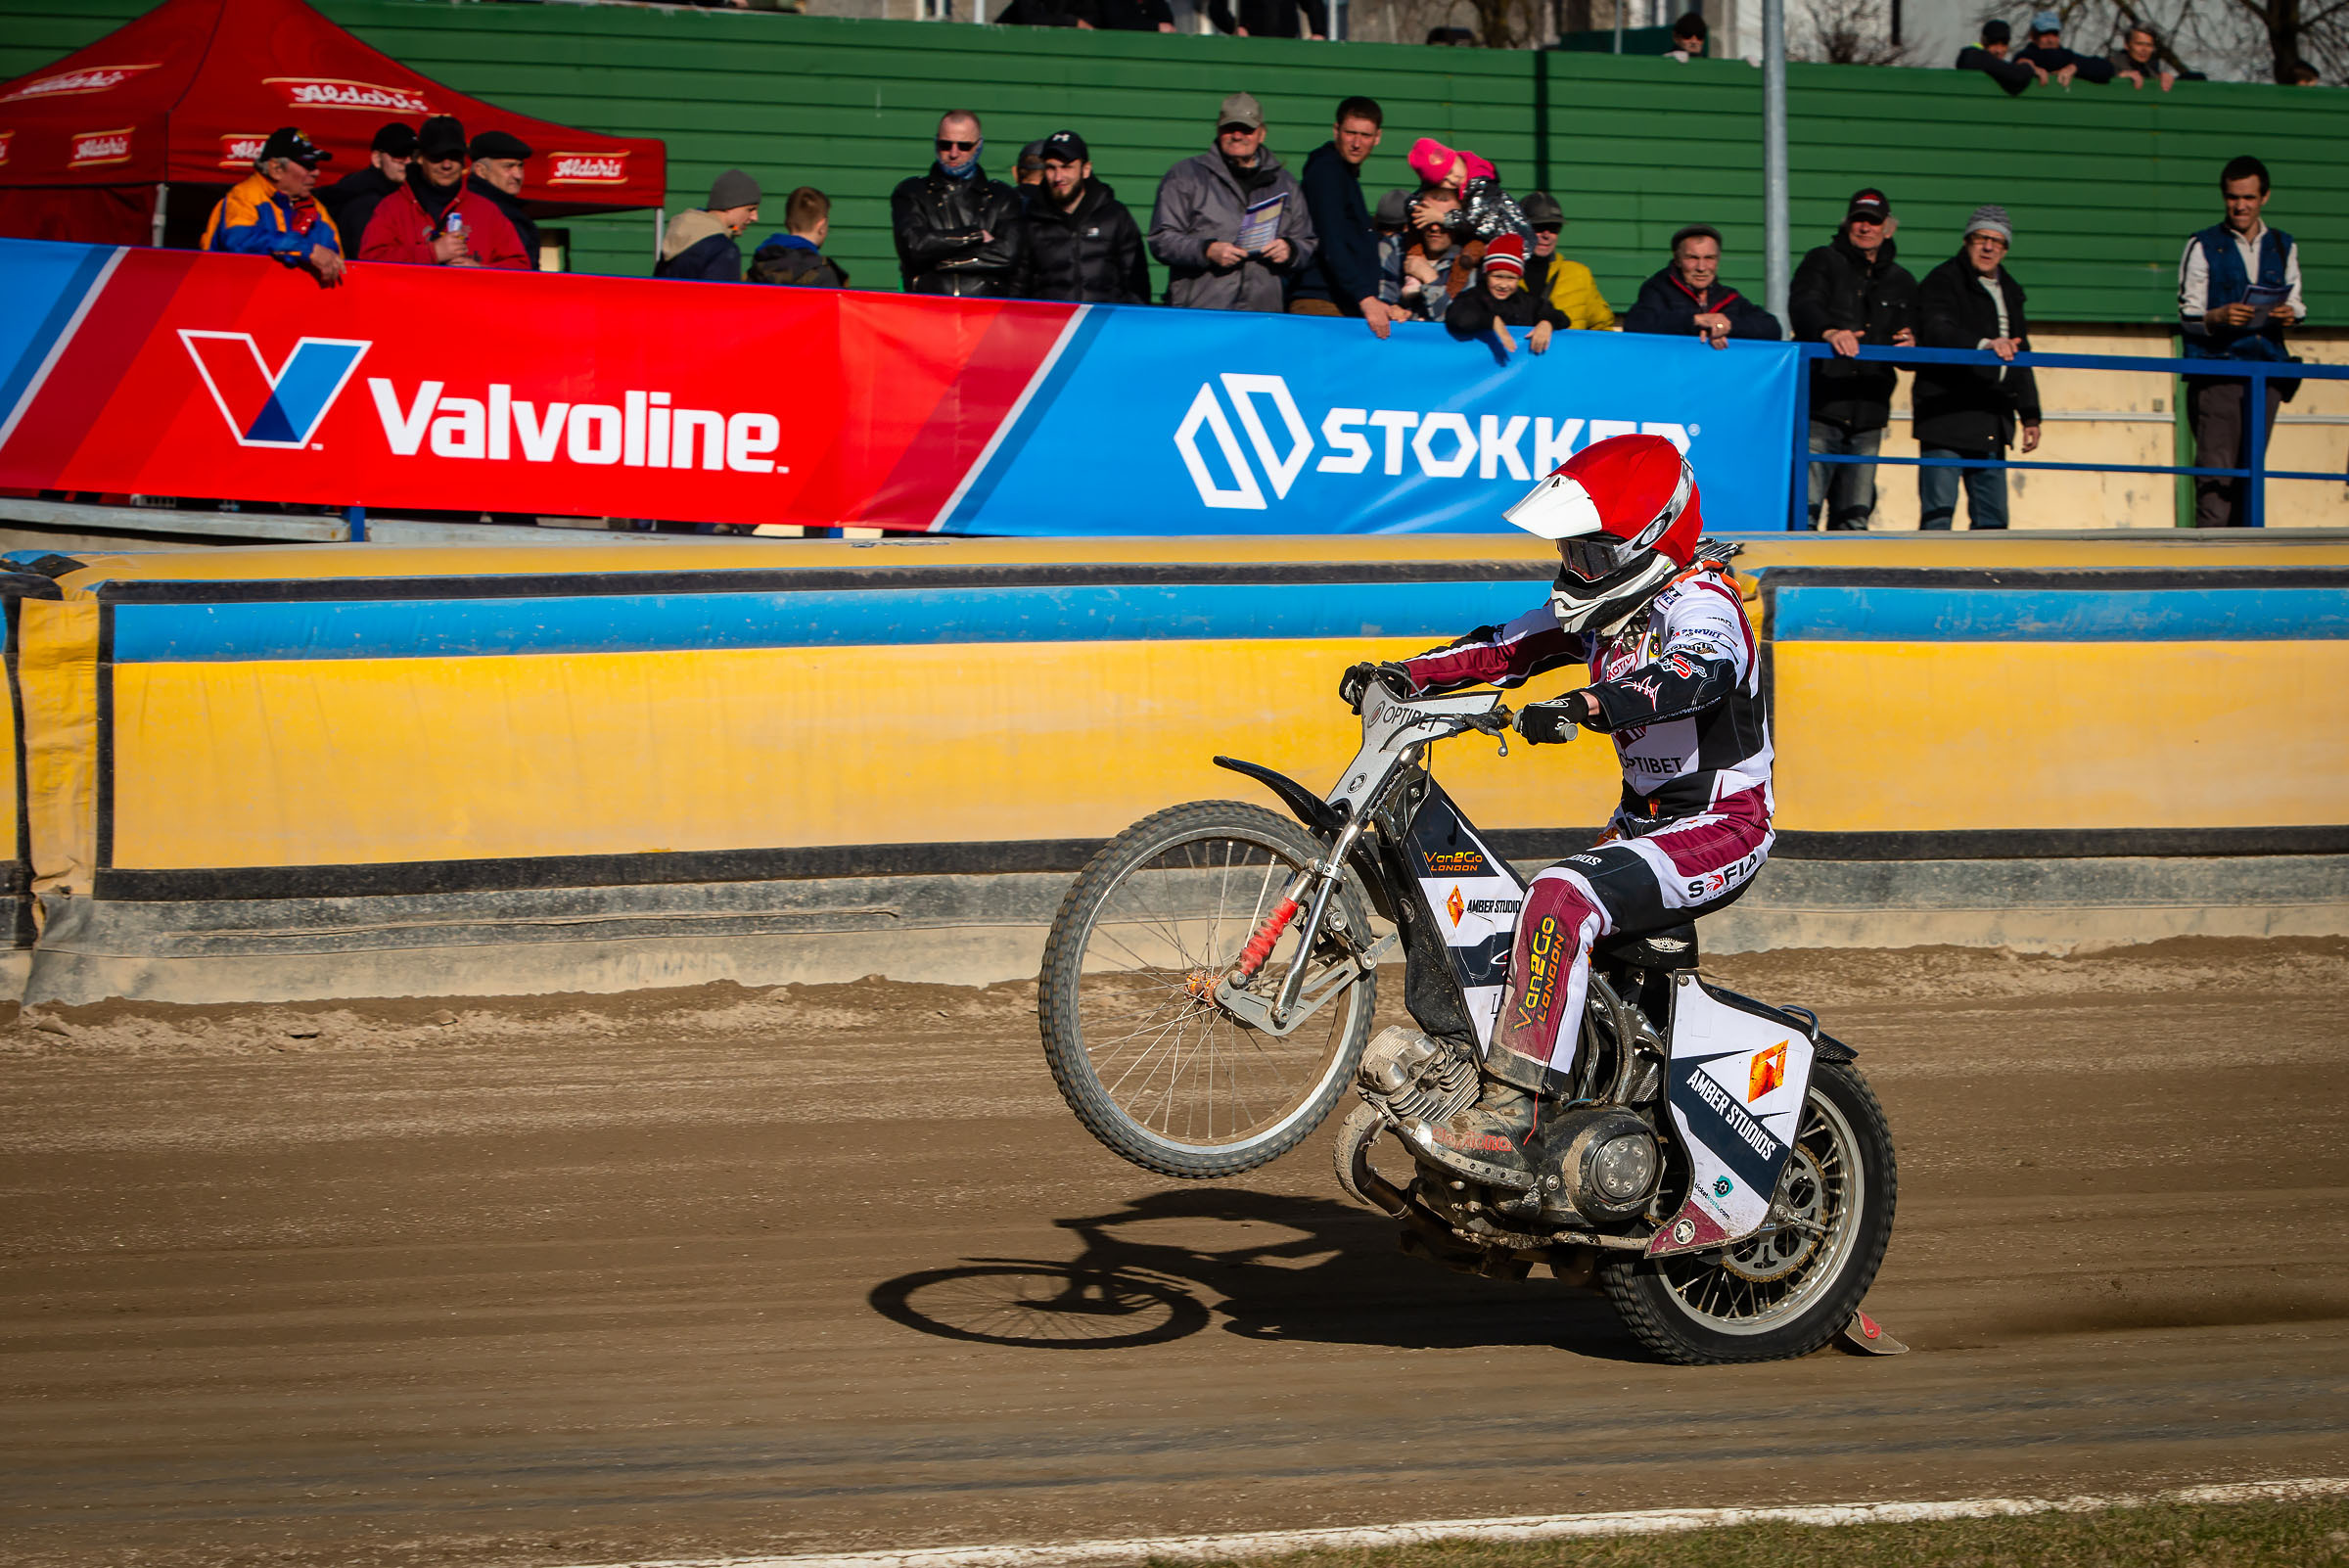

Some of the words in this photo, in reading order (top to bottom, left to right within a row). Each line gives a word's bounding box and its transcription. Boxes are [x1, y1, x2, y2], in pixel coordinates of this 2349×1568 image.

[291, 85, 429, 112] Aldaris
[74, 137, 128, 159] Aldaris
[553, 158, 622, 178] Aldaris
[368, 378, 781, 473] Valvoline
[1316, 408, 1691, 481] STOKK
[1424, 852, 1483, 863] Van2Go
[1467, 900, 1493, 913] AMBER
[1495, 900, 1524, 913] STUDIO
[1514, 917, 1555, 1029] Van2Go
[1537, 933, 1565, 1023] LONDON
[1685, 1069, 1730, 1117] AMBER
[1725, 1104, 1777, 1161] STUDIOS
